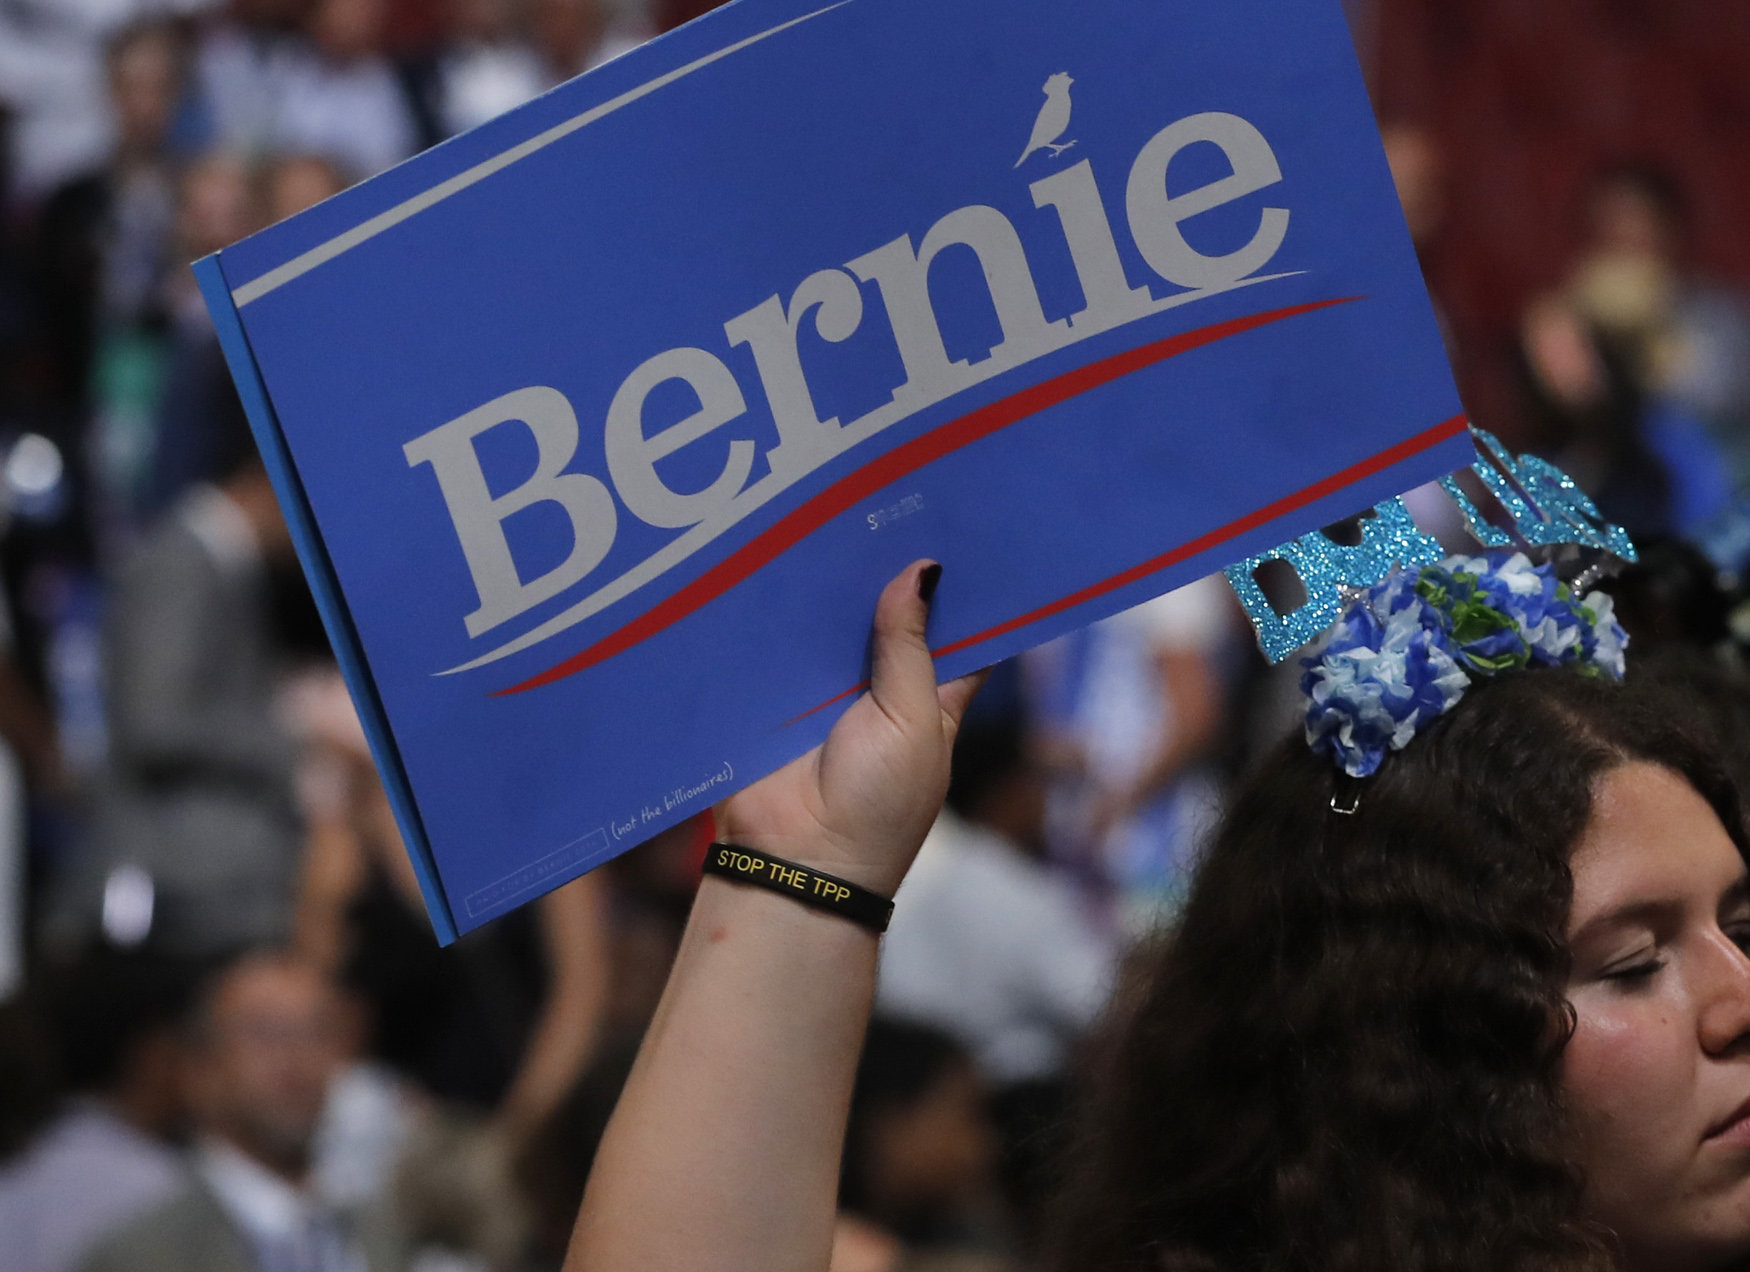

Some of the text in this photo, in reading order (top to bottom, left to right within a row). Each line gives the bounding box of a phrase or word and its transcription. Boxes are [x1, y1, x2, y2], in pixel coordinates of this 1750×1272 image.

[402, 110, 1290, 640] Bernie
[641, 806, 662, 824] the
[717, 850, 851, 902] STOP THE TPP
